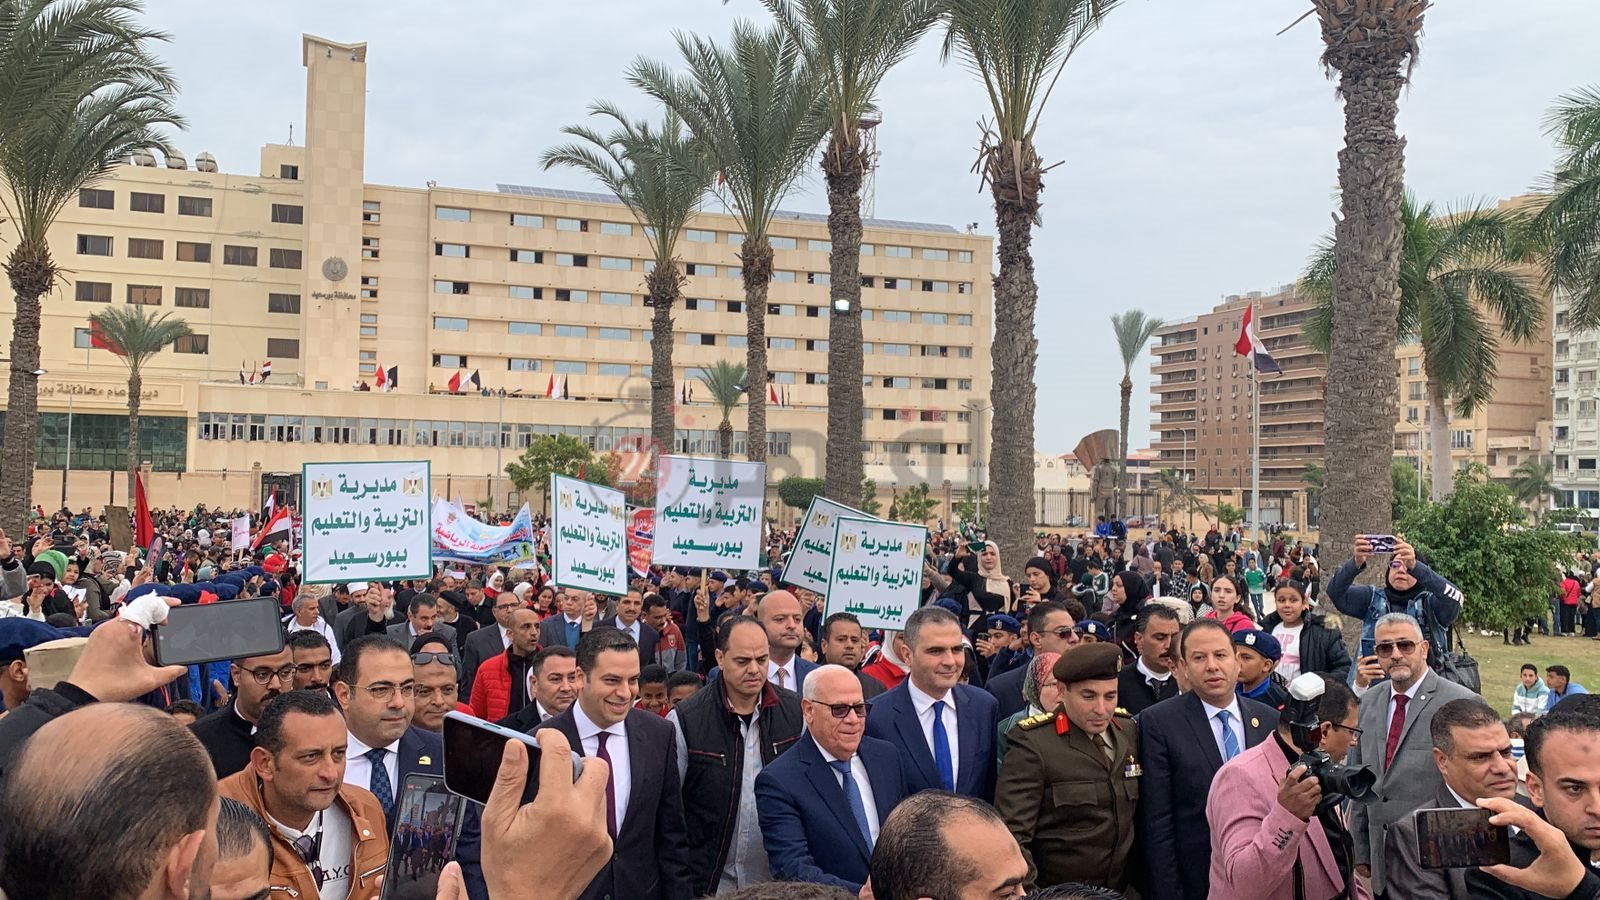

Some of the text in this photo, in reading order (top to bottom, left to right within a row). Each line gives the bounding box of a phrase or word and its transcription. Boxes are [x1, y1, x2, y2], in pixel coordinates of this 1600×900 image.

[338, 473, 397, 500] مديرية
[688, 468, 739, 495] مديرية
[575, 489, 608, 519] مديرية
[663, 501, 756, 527] التربية والتعليم
[311, 510, 371, 536] والتعليم
[374, 507, 424, 534] التربية
[560, 522, 595, 548] والتعليم
[595, 526, 624, 552] التربية
[672, 535, 743, 559] ببورسعيد
[800, 537, 832, 557] تعليم
[861, 530, 903, 558] مديرية
[328, 548, 408, 571] ببورسعيد
[570, 556, 616, 585] ببورسعيد
[835, 563, 880, 587] والتعليم
[882, 565, 918, 590] التربية
[844, 598, 903, 623] ببورسعيد
